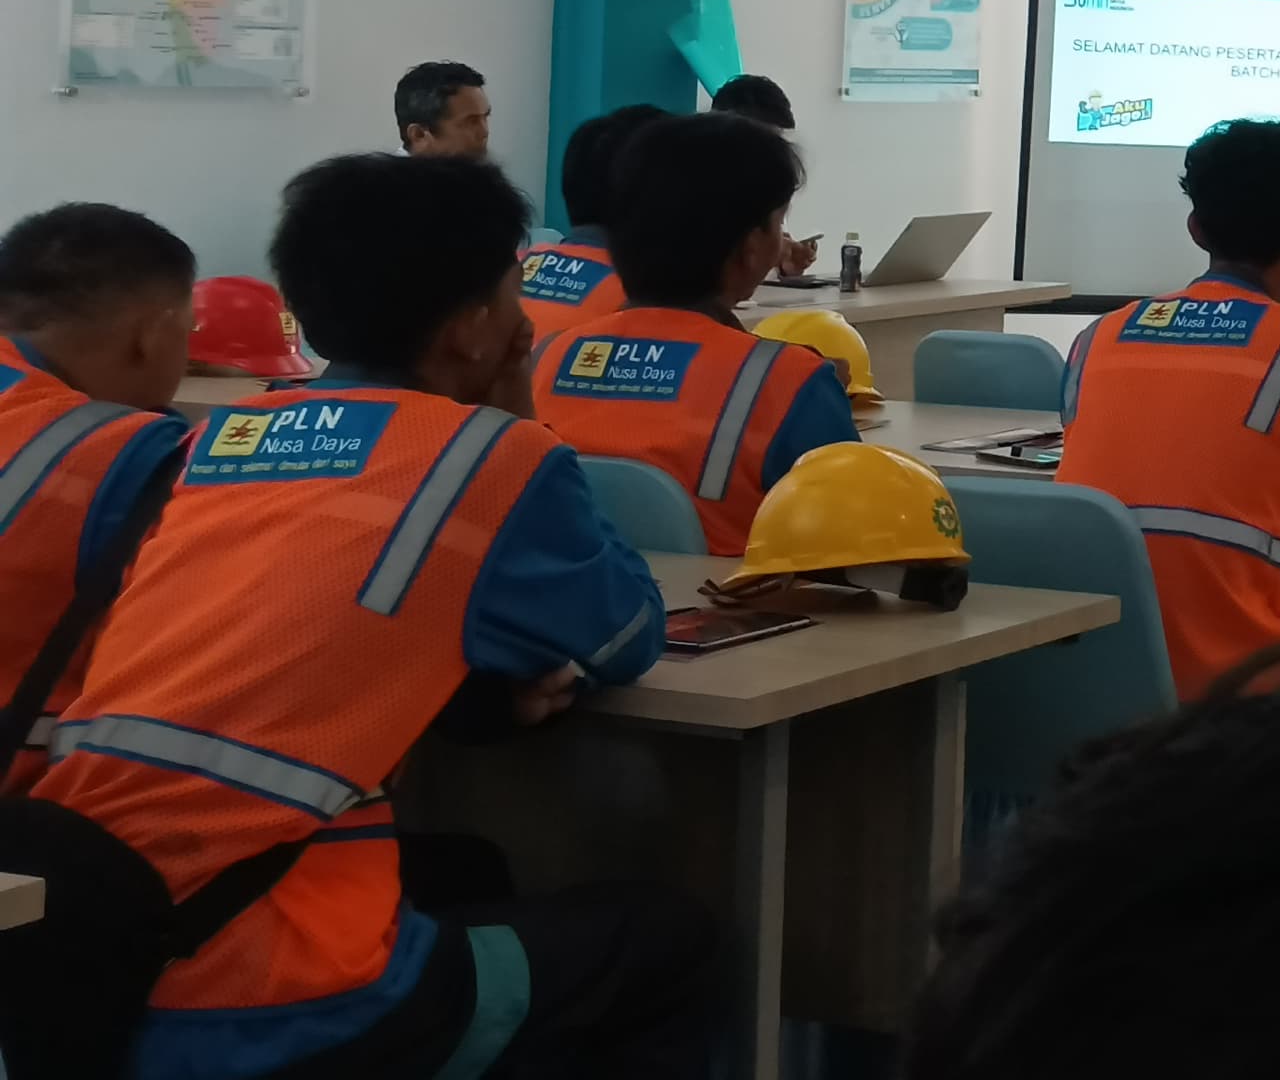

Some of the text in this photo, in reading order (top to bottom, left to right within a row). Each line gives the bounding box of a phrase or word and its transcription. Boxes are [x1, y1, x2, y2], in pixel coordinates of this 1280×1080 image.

[1072, 39, 1144, 55] SELAMAT
[1150, 43, 1211, 58] DATANG
[1231, 66, 1280, 79] BATCH
[542, 255, 585, 274] PLN
[1180, 301, 1233, 315] PLN
[1173, 315, 1247, 330] Nusa Daya
[614, 344, 665, 362] PLN
[607, 366, 675, 382] Nusa Daya
[271, 406, 344, 433] PLN
[259, 434, 361, 453] Nusa Daya
